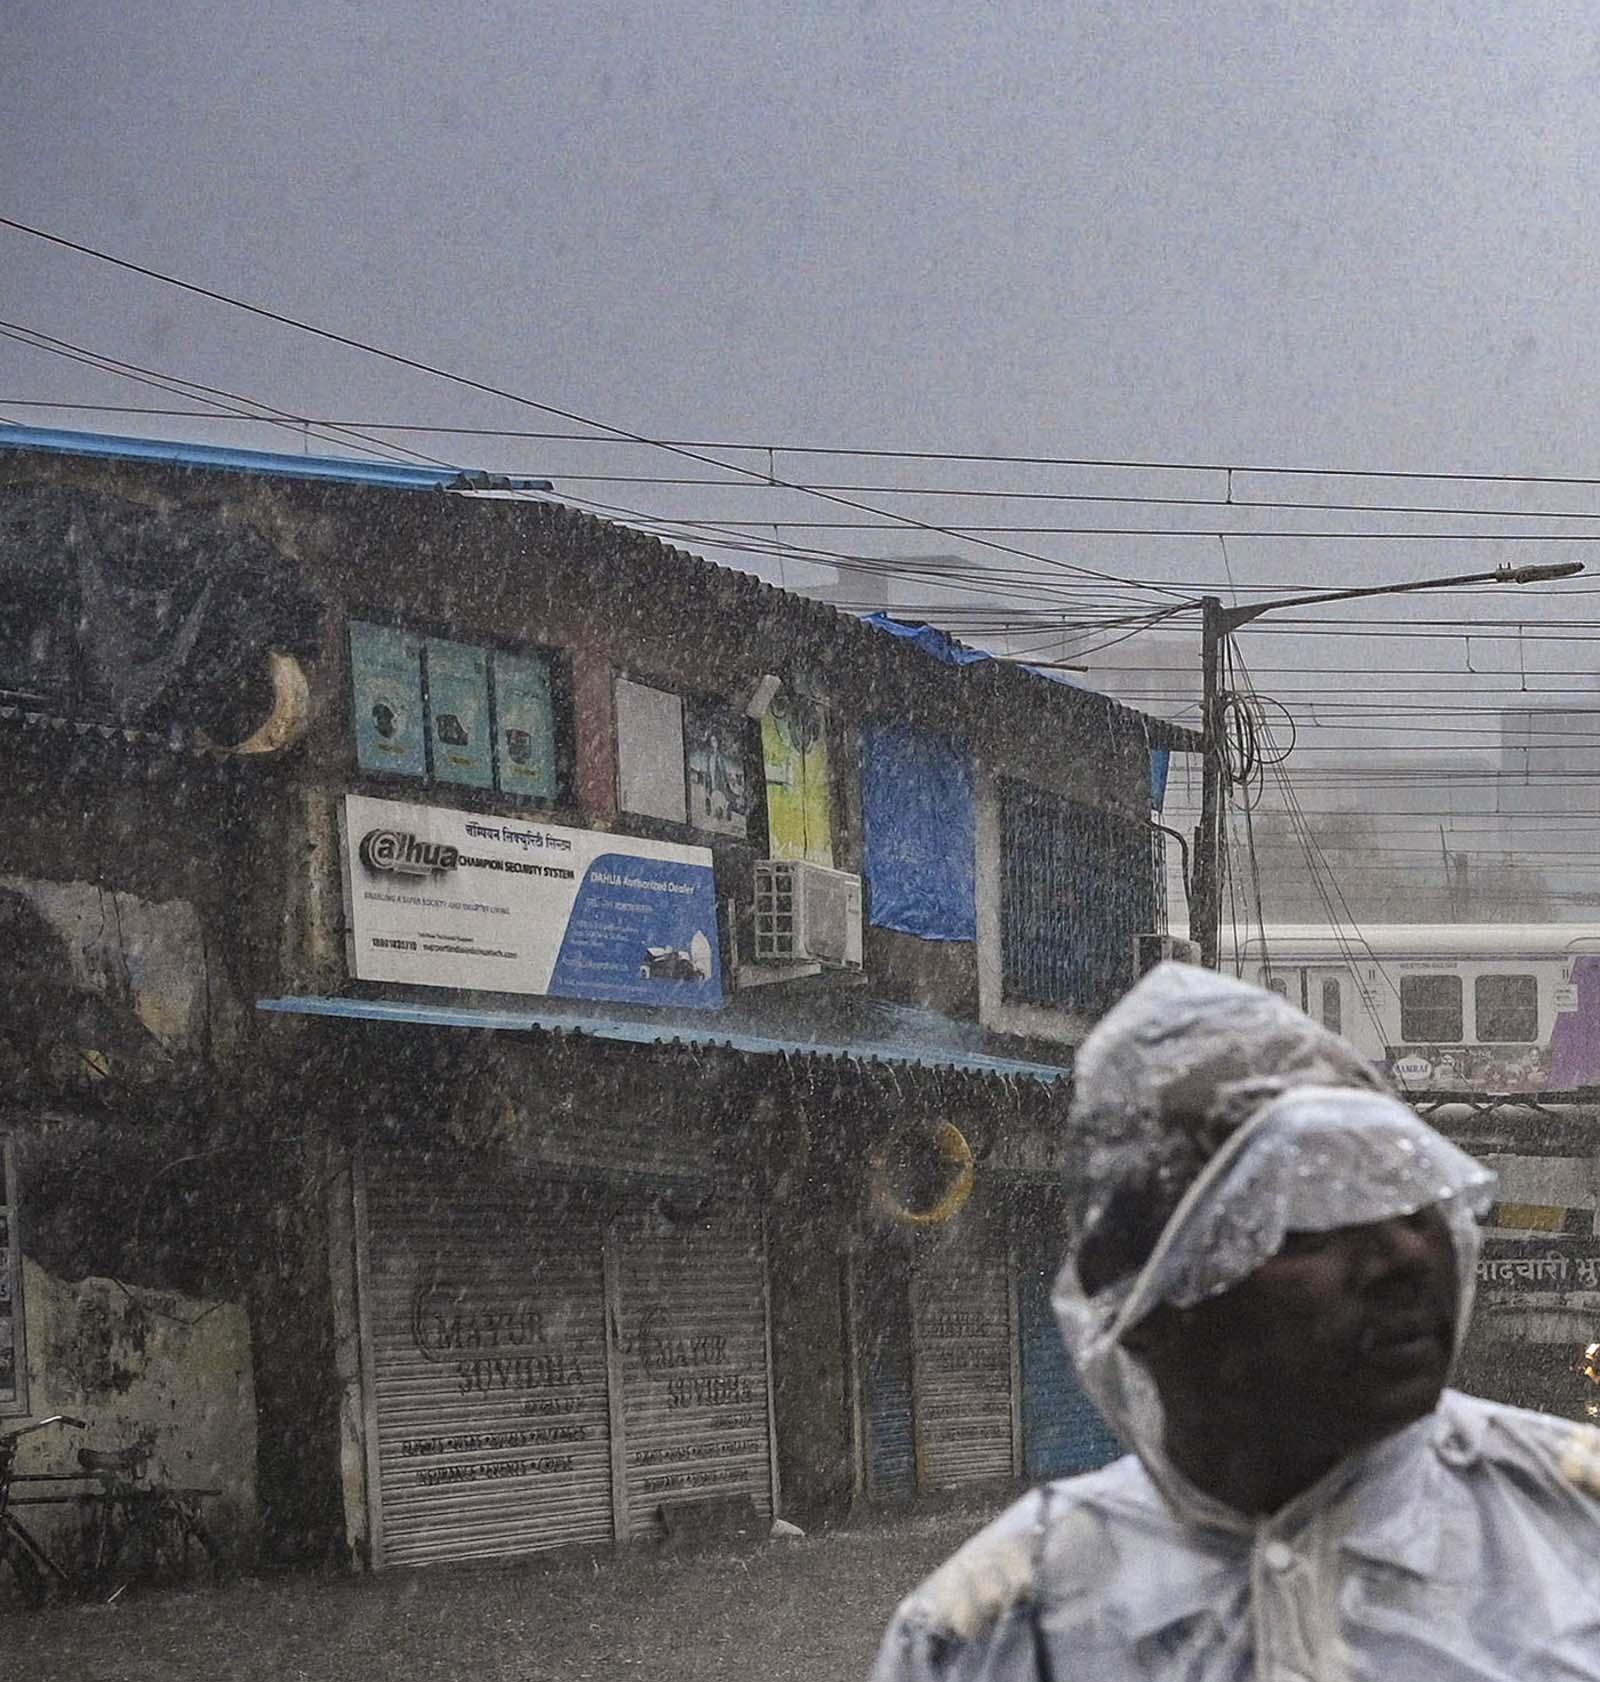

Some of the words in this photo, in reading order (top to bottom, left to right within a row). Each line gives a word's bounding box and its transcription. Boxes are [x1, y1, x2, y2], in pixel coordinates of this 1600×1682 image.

[458, 857, 503, 871] CHAMPION
[504, 861, 543, 875] SECURITY
[543, 867, 575, 880] SYSTEM
[591, 872, 621, 887] DAHUA
[1476, 1250, 1571, 1285] पादचारी
[434, 1311, 547, 1349] MAYUR
[656, 1336, 726, 1367] MAYUR
